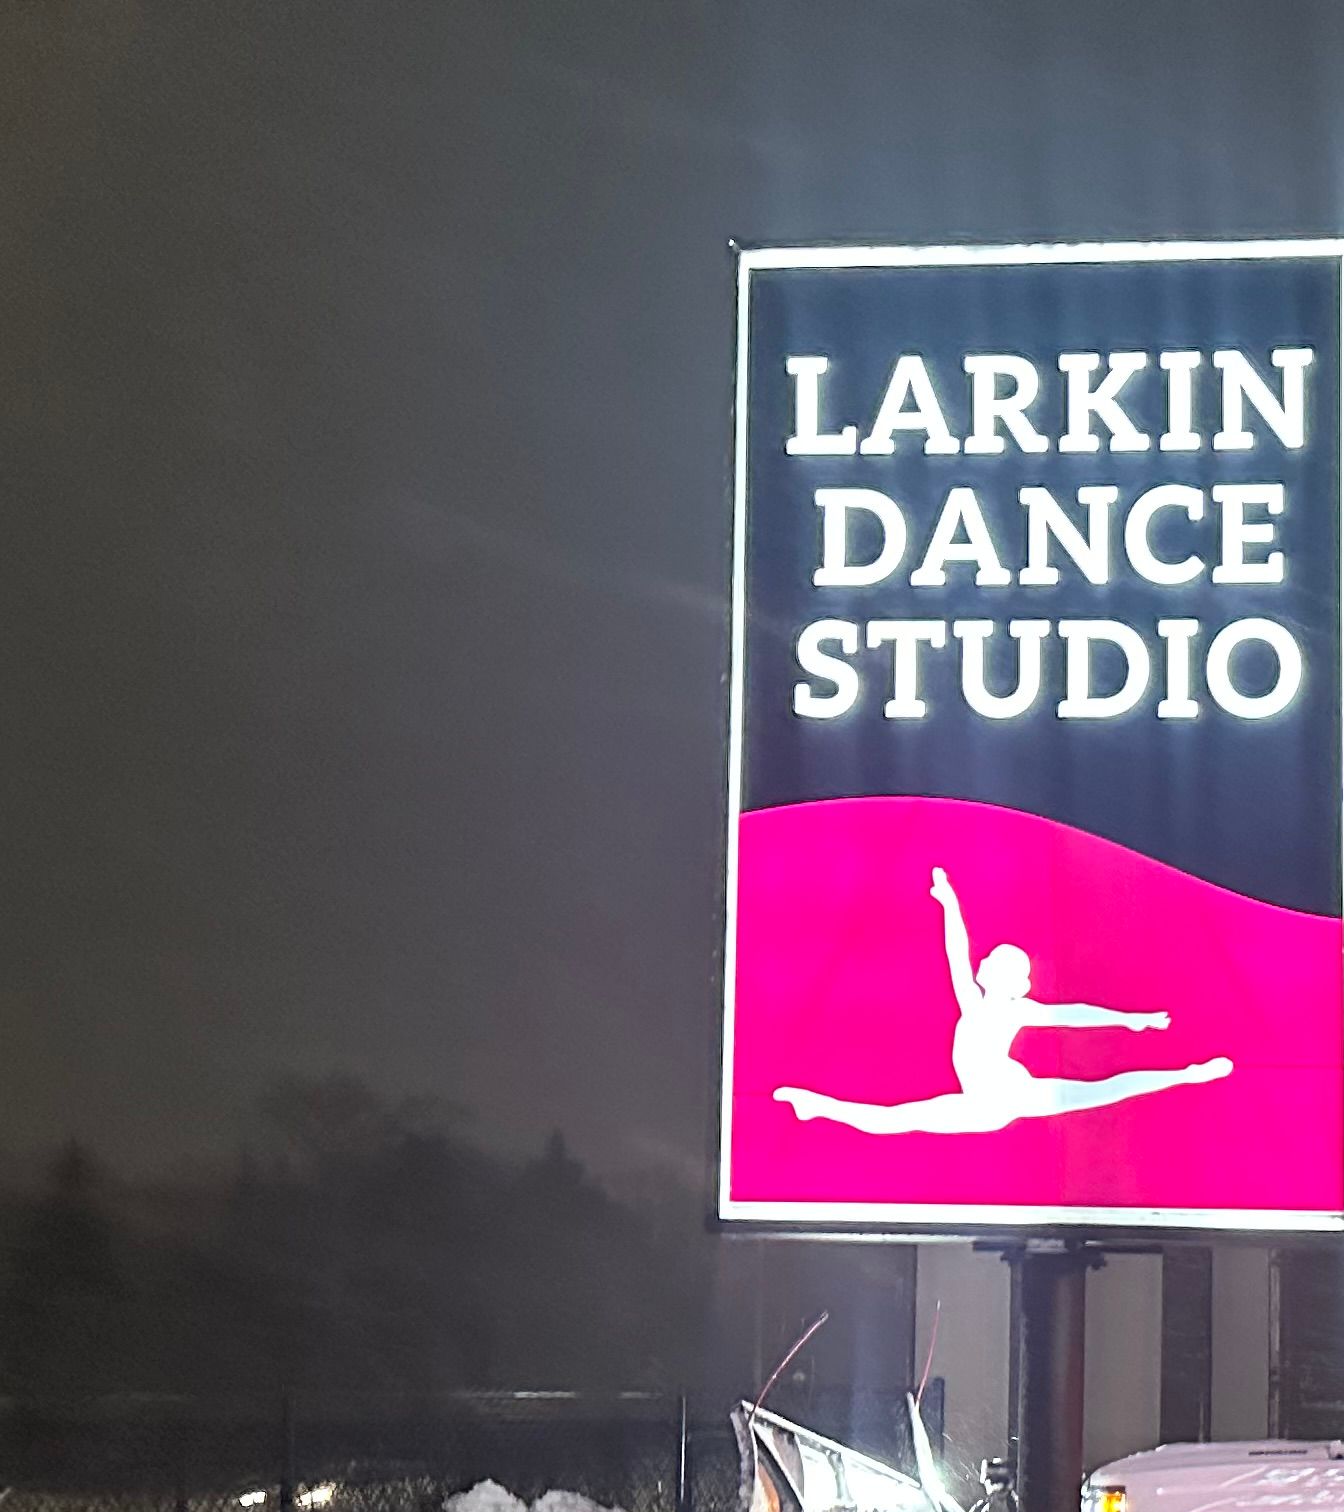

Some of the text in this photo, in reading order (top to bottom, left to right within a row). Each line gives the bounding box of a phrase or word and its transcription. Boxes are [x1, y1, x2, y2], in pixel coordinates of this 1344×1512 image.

[787, 349, 1312, 454] LARKIN
[814, 484, 1283, 585] DANCE
[795, 619, 1302, 718] STUDIO
